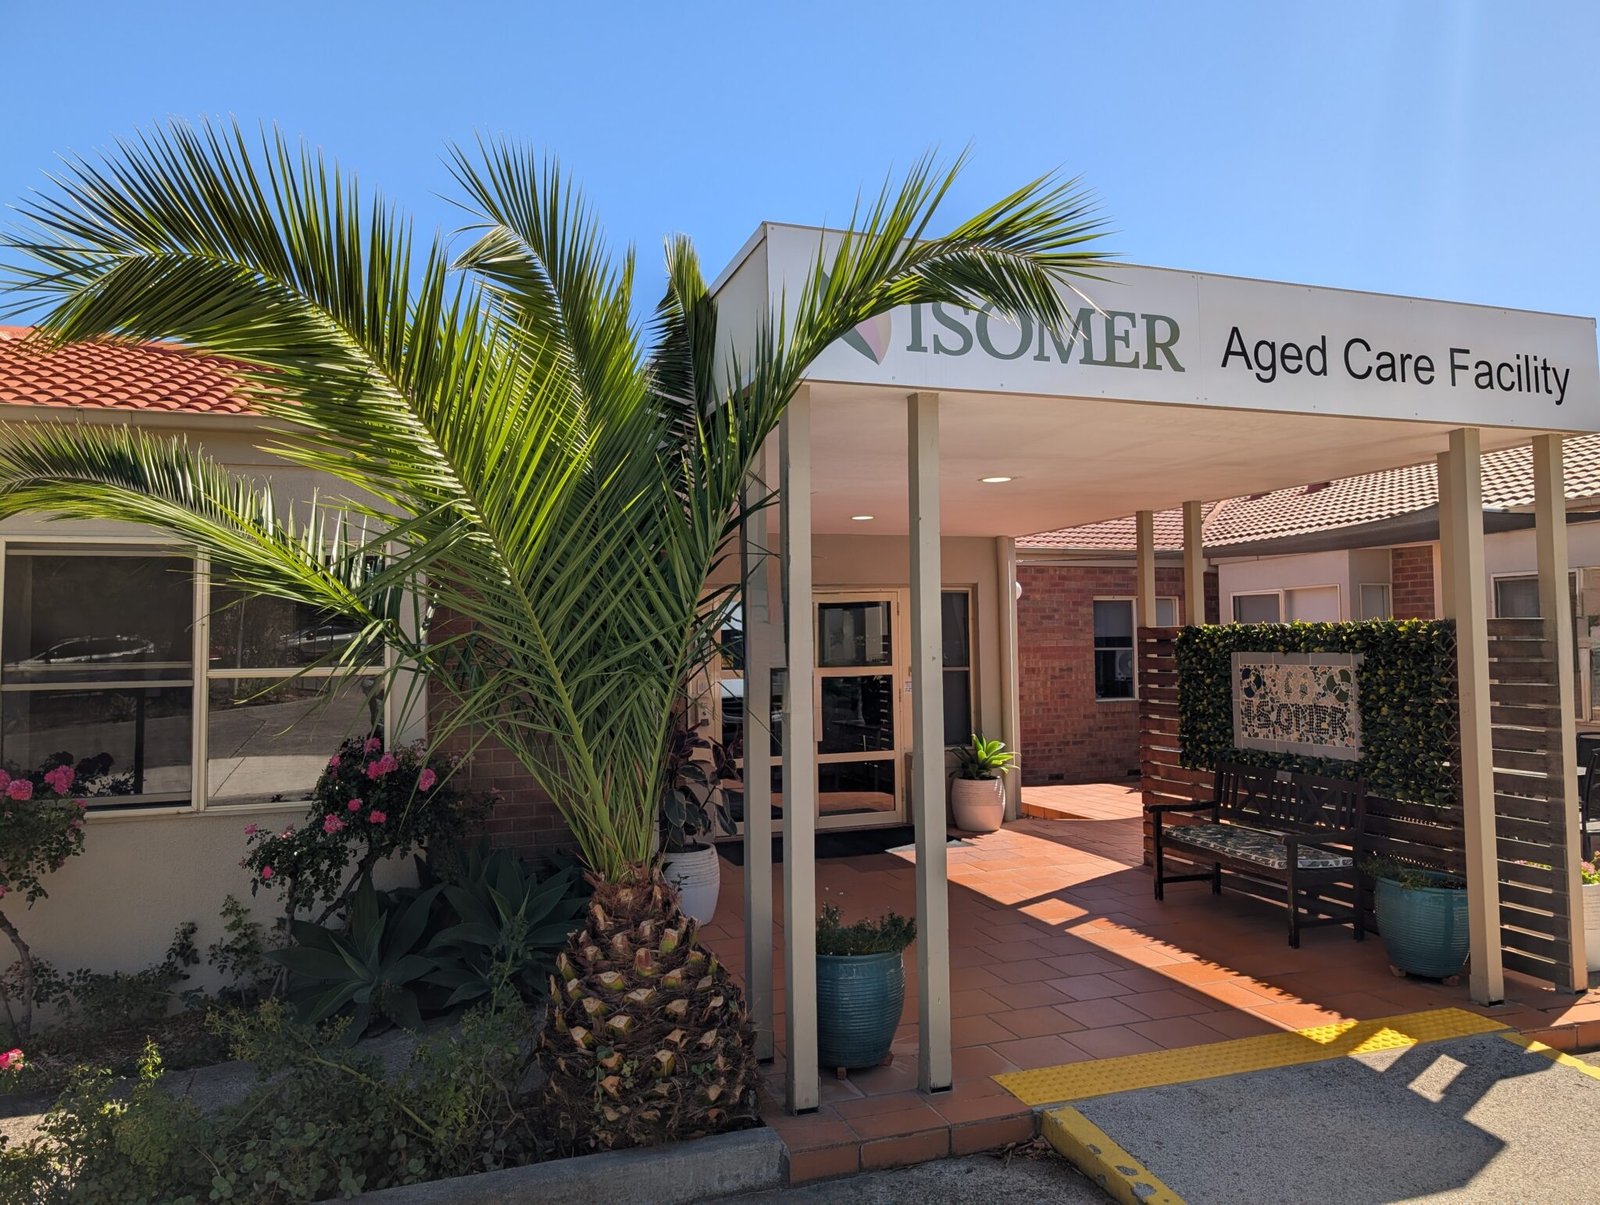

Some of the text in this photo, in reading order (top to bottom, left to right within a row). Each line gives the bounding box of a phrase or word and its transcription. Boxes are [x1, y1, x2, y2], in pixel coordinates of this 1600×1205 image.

[905, 300, 1570, 406] ISOMER Aged Care Facility
[1245, 699, 1348, 738] ISOMER
